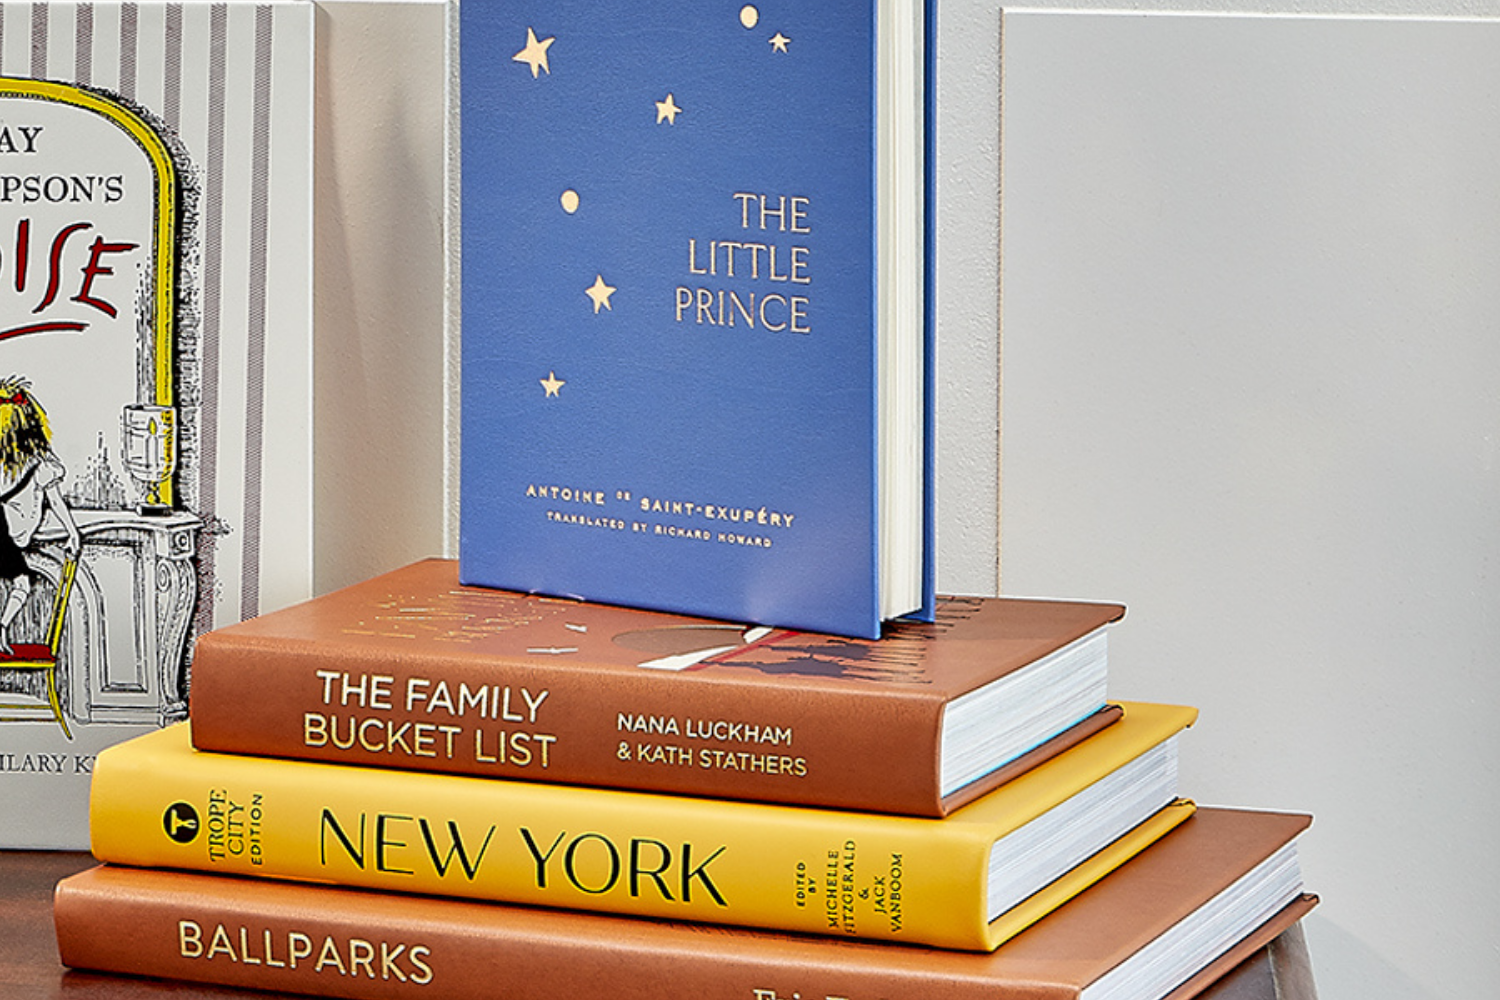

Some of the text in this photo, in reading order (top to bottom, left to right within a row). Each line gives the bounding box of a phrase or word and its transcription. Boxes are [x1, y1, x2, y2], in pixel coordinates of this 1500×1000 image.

[733, 192, 811, 234] THE
[688, 239, 811, 284] LITTLE
[675, 286, 811, 334] PRINCE
[526, 484, 605, 506] ANTOINE
[640, 497, 795, 528] SAINT-EXUPÉRY
[546, 510, 772, 548] TRANSLATED BY RICHARD HOWARD
[316, 671, 549, 724] THE FAMILY
[303, 714, 556, 768] BUCKET LIST
[616, 712, 792, 746] NANA LUCKHAM
[616, 745, 807, 776] & KATH STATHERS
[208, 789, 227, 862] TROPE
[228, 801, 244, 855] CITY
[250, 794, 263, 865] EDITION
[319, 808, 728, 906] NEW YORK
[826, 851, 839, 928] MICHELLE
[874, 876, 887, 914] JACK
[890, 853, 903, 932] VANBOOM
[178, 920, 434, 984] BALLPARKS
